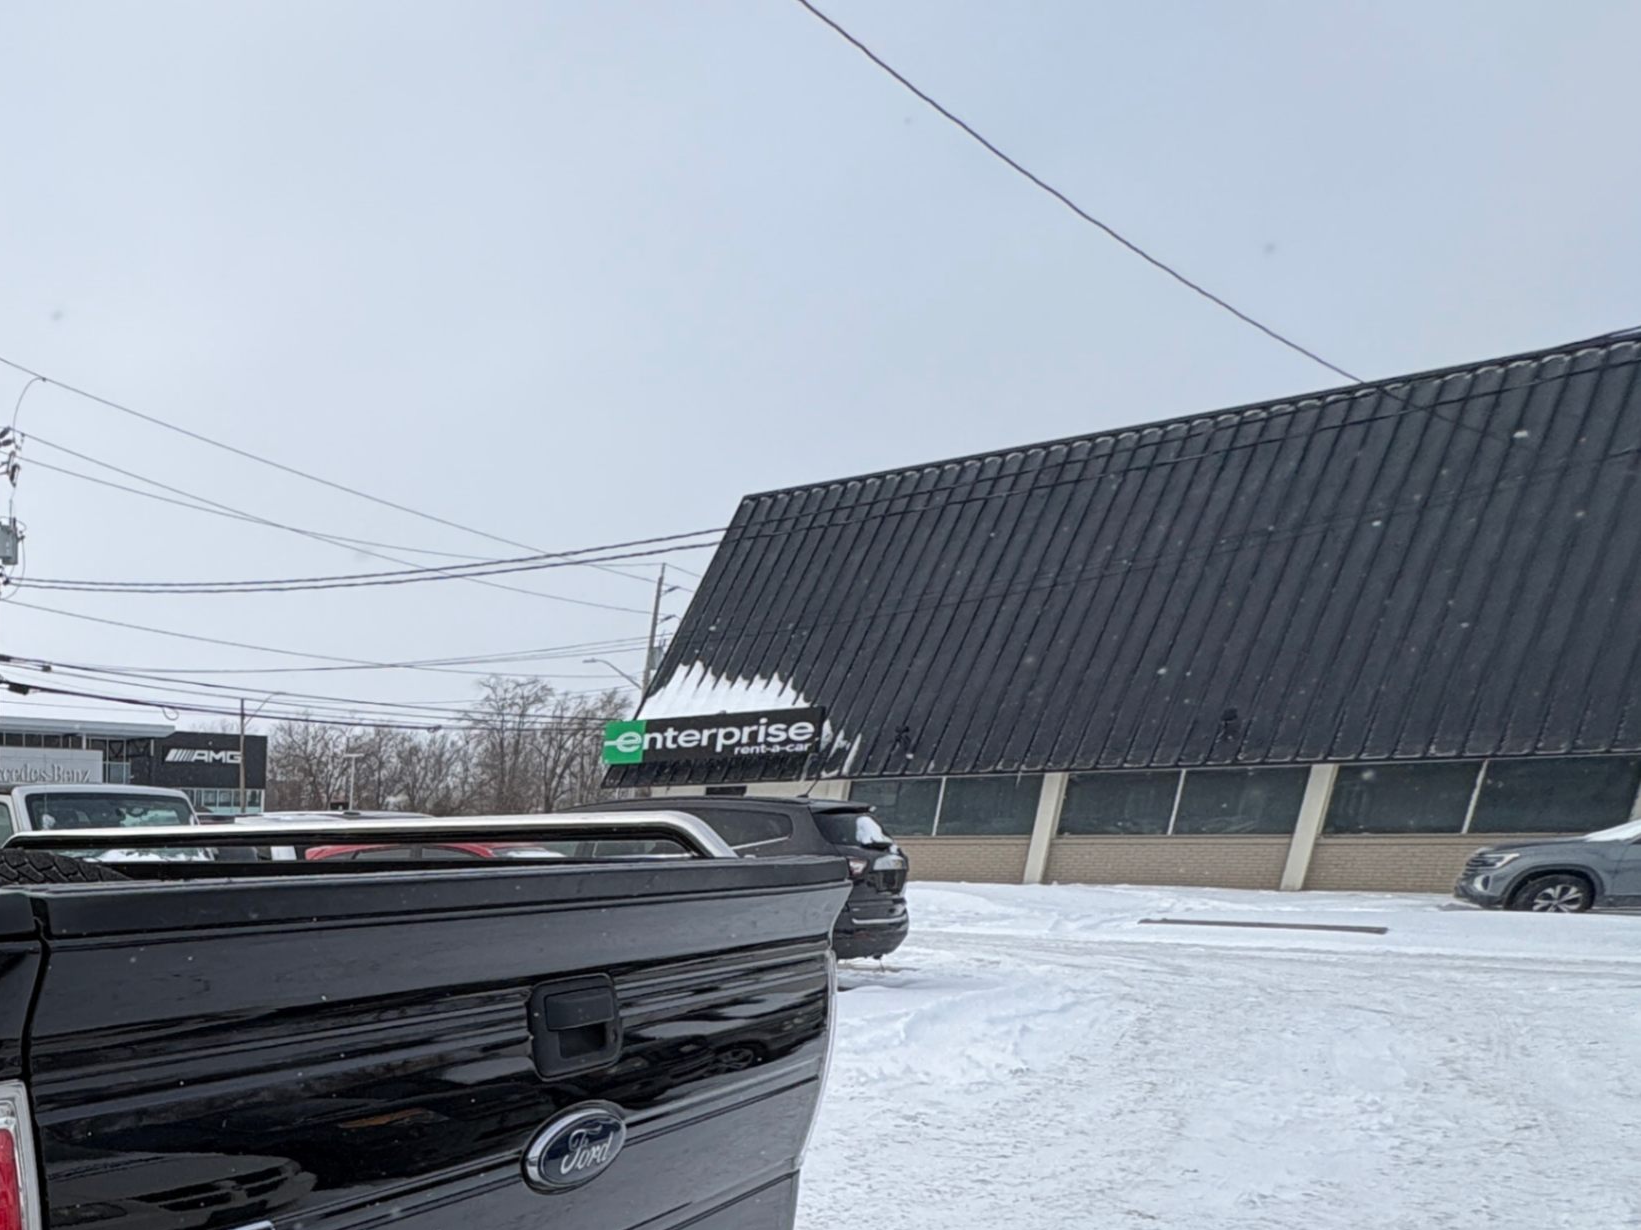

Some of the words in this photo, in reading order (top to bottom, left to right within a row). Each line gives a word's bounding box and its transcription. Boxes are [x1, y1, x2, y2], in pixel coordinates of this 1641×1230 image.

[604, 717, 815, 753] enterprise
[192, 751, 242, 764] AMG
[733, 742, 812, 755] rent-a-car
[560, 1125, 614, 1175] Ford
